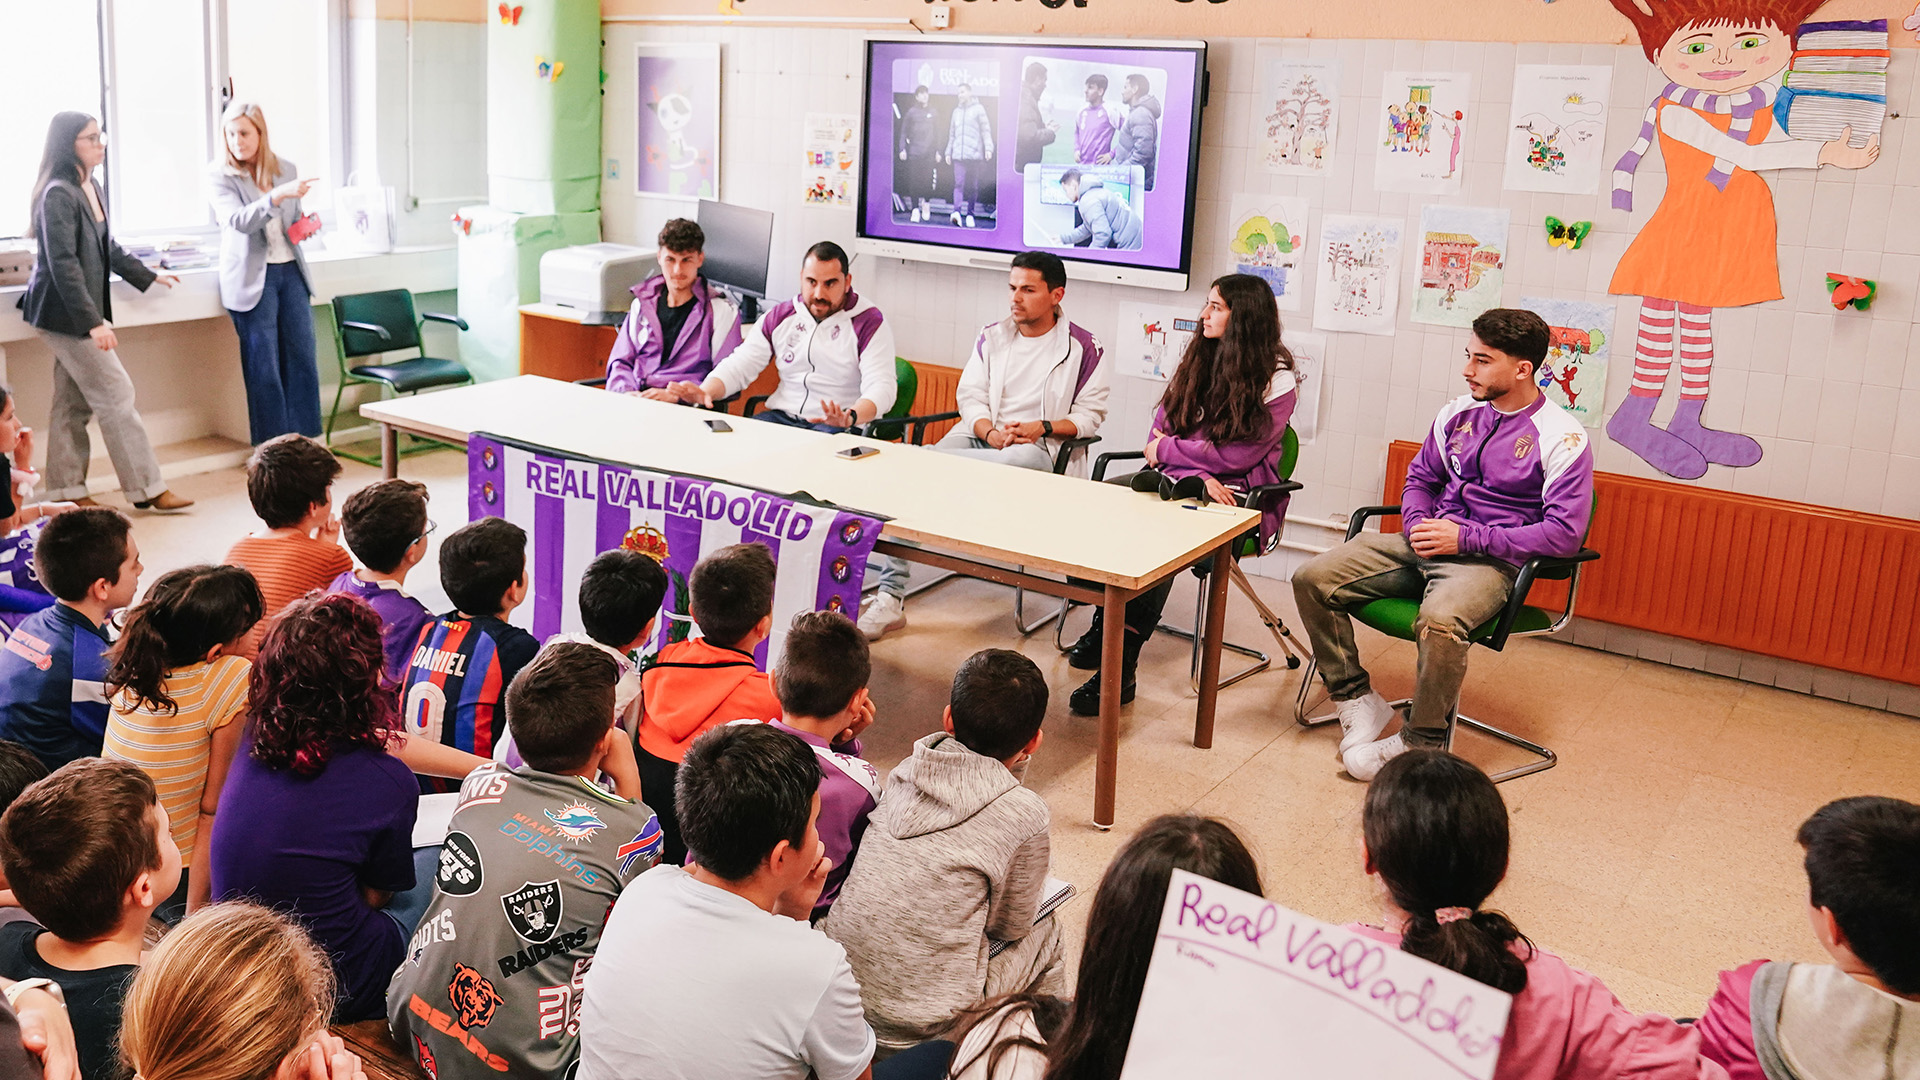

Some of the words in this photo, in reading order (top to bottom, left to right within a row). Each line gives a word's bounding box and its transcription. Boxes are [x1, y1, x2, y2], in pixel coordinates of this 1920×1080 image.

[526, 460, 597, 501] REAL
[606, 472, 814, 542] VALLADOLID
[411, 644, 467, 678] DANIEL
[498, 818, 600, 888] Dolphins
[512, 812, 557, 837] MIAMI
[507, 884, 555, 905] RAIDERS
[1178, 883, 1278, 950] Real
[497, 926, 589, 979] RAIDERS
[408, 992, 510, 1073] BEARS
